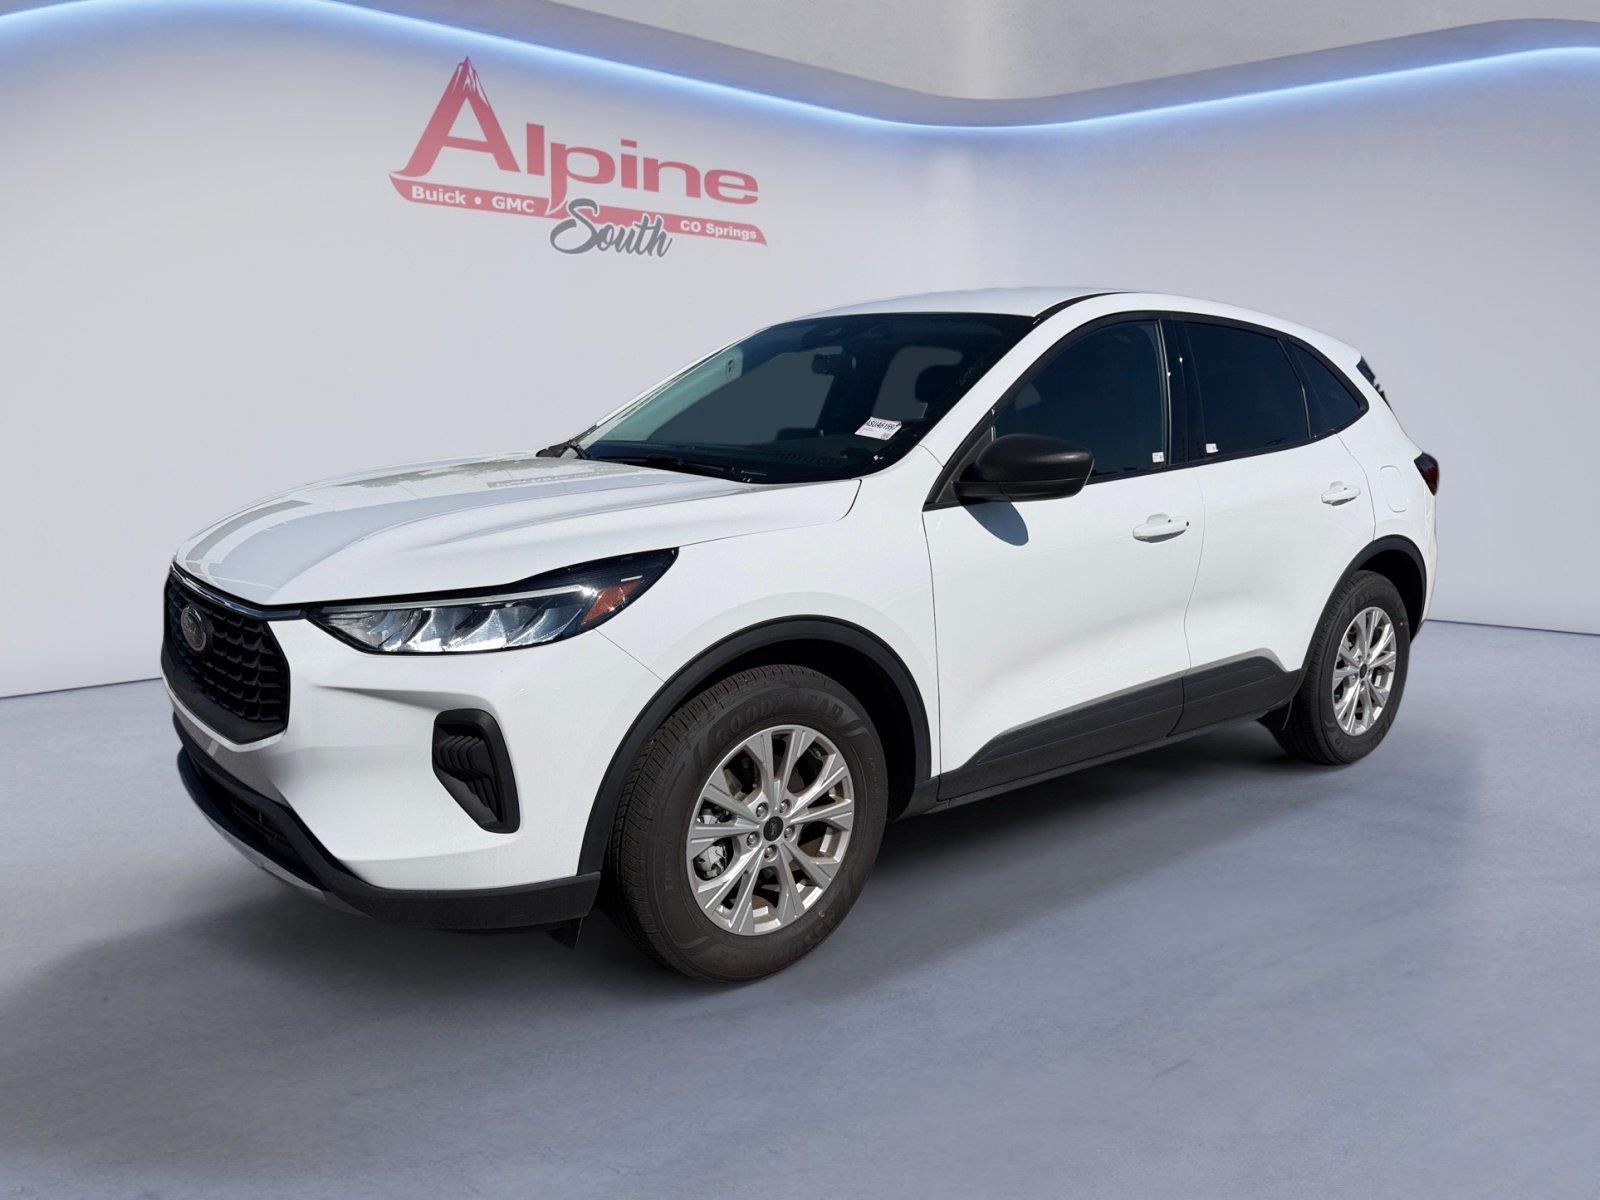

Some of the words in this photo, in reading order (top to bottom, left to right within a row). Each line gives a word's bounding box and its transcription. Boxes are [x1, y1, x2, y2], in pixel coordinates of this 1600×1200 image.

[391, 56, 758, 214] Alpine
[411, 185, 466, 205] Buick
[491, 196, 535, 213] GMC
[550, 198, 673, 257] South
[680, 220, 701, 232] CO
[706, 222, 757, 241] Springs
